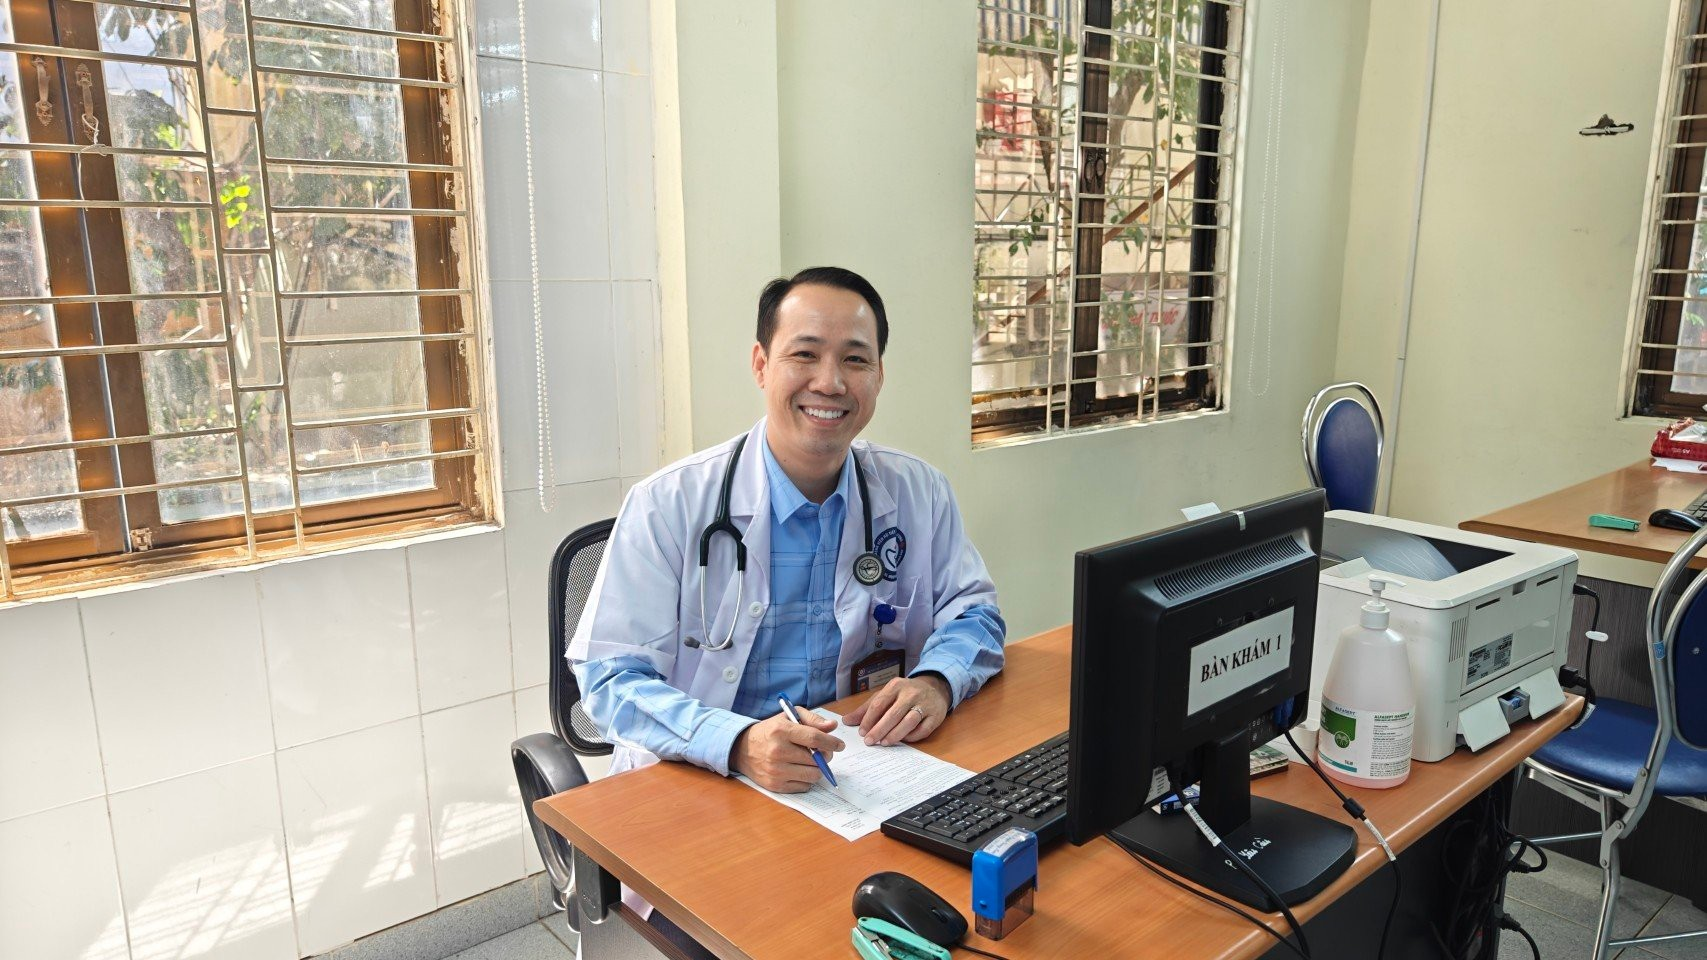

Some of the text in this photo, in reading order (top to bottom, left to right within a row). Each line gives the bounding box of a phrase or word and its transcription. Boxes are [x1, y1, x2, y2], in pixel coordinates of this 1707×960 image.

[1201, 634, 1282, 683] BÀN KHÁM 1
[1335, 706, 1355, 715] ALFASEPT
